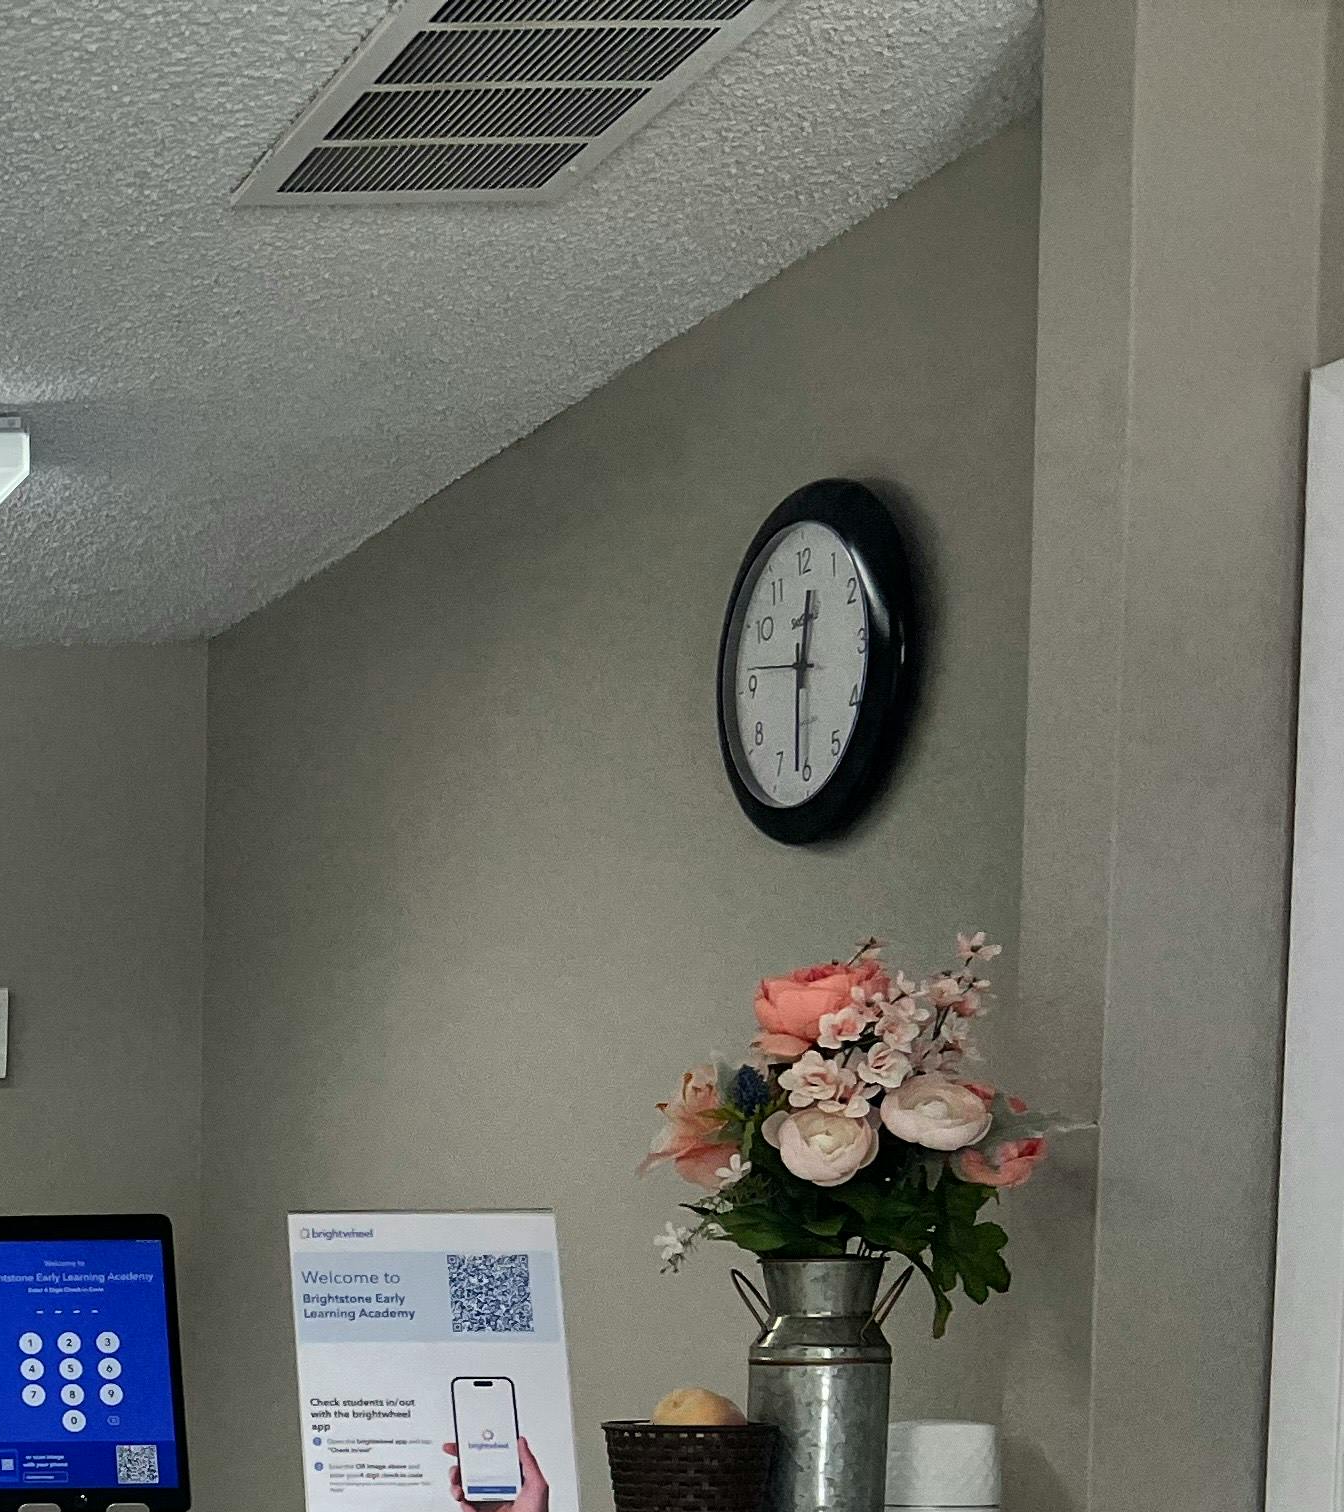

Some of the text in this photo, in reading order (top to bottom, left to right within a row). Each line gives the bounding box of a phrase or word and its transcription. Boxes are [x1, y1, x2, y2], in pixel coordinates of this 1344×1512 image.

[796, 547, 812, 576] 12
[831, 552, 836, 576] 1
[771, 578, 784, 606] 11
[847, 577, 858, 604] 2
[756, 616, 774, 644] 10
[748, 675, 758, 699] 9
[849, 684, 861, 707] 4
[755, 721, 764, 746] 8
[831, 729, 841, 756] 5
[776, 751, 784, 777] 7
[802, 757, 812, 782] 6
[312, 1227, 374, 1240] brightwheel
[36, 1272, 60, 1284] Early
[62, 1272, 105, 1284] Learning
[107, 1271, 154, 1283] Academy
[301, 1270, 401, 1284] Welcome to
[303, 1292, 406, 1306] Brightstone Early
[303, 1307, 416, 1321] Learning Academy
[27, 1338, 33, 1347] 1
[65, 1338, 73, 1347] 2
[105, 1337, 111, 1347] 3
[28, 1364, 35, 1372] 4
[67, 1364, 74, 1373] 5
[106, 1364, 113, 1373] 6
[30, 1390, 37, 1399] 7
[69, 1390, 76, 1399] 8
[108, 1389, 115, 1398] 9
[310, 1397, 340, 1407] Check
[342, 1397, 384, 1407] students
[70, 1416, 78, 1425] 0
[310, 1409, 411, 1420] with the brightwheel
[311, 1423, 331, 1432] app
